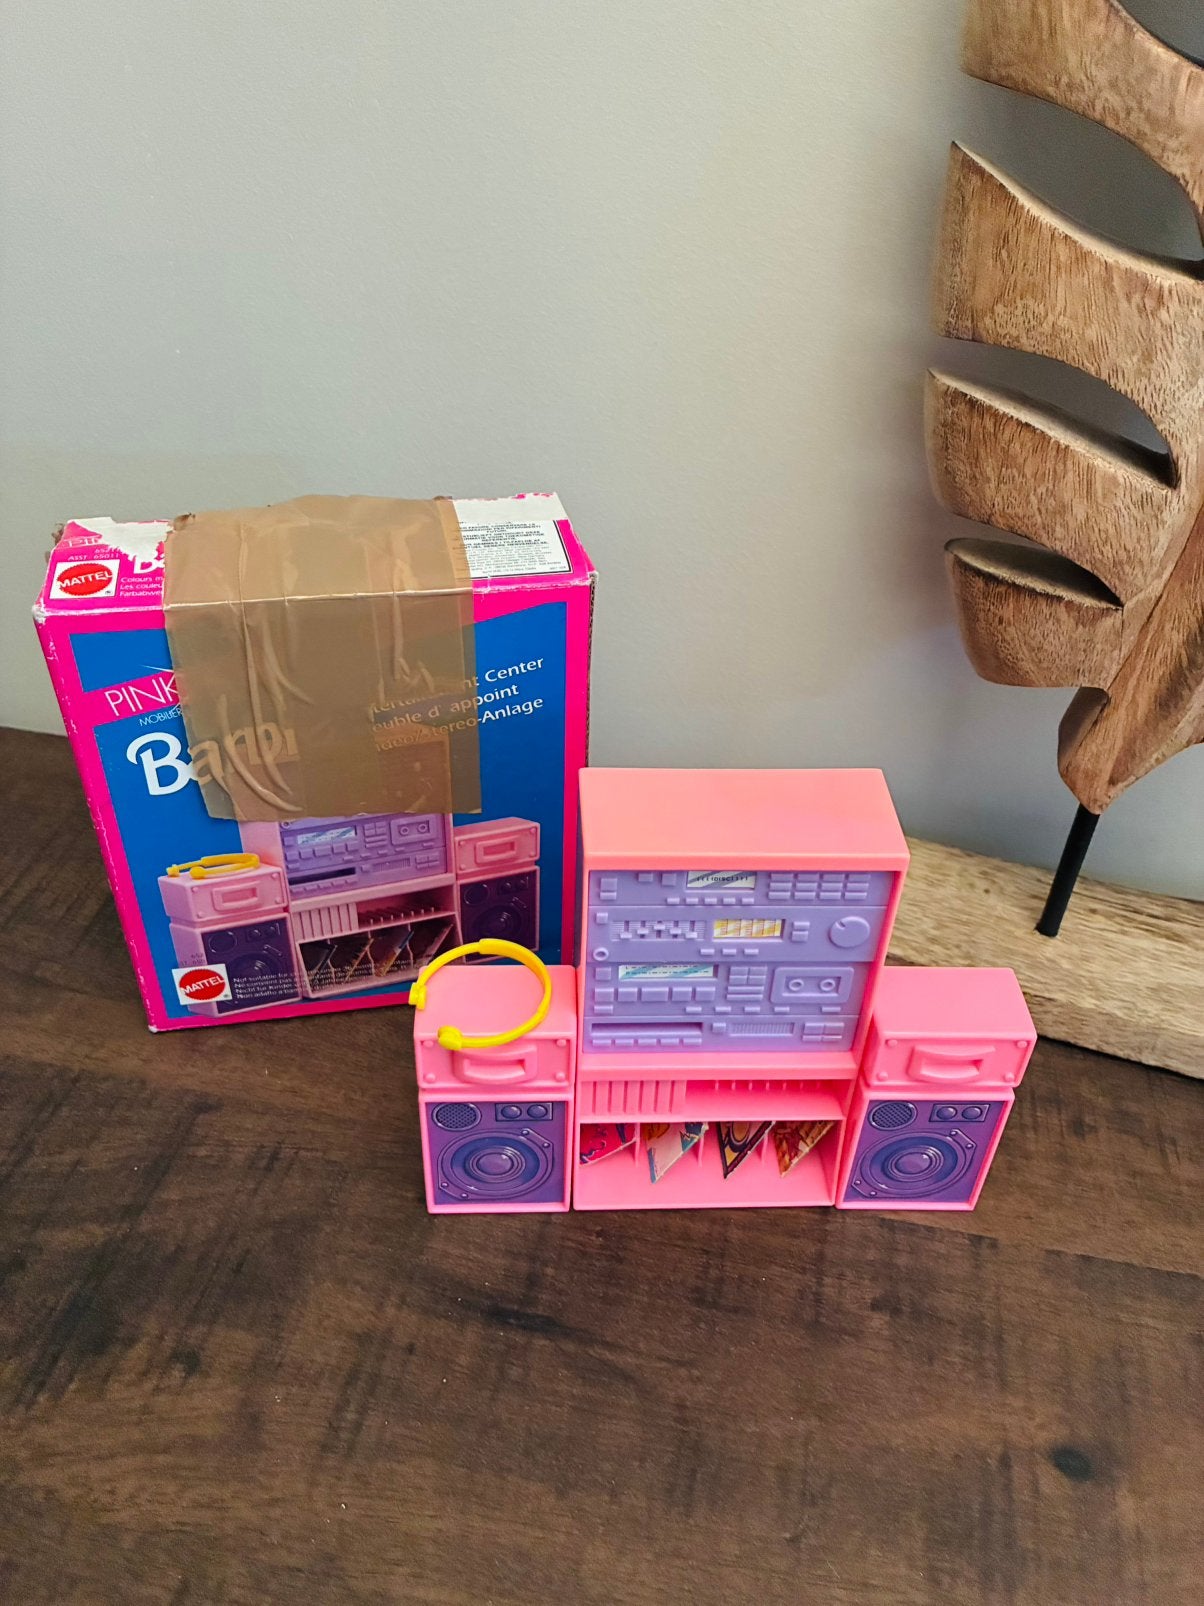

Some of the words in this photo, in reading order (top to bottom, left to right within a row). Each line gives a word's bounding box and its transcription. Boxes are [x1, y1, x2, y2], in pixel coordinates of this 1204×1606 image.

[58, 570, 113, 589] MATTEL
[485, 657, 544, 682] Center
[104, 677, 180, 717] PINK
[449, 683, 519, 715] appoint
[180, 975, 226, 996] MATTEL
